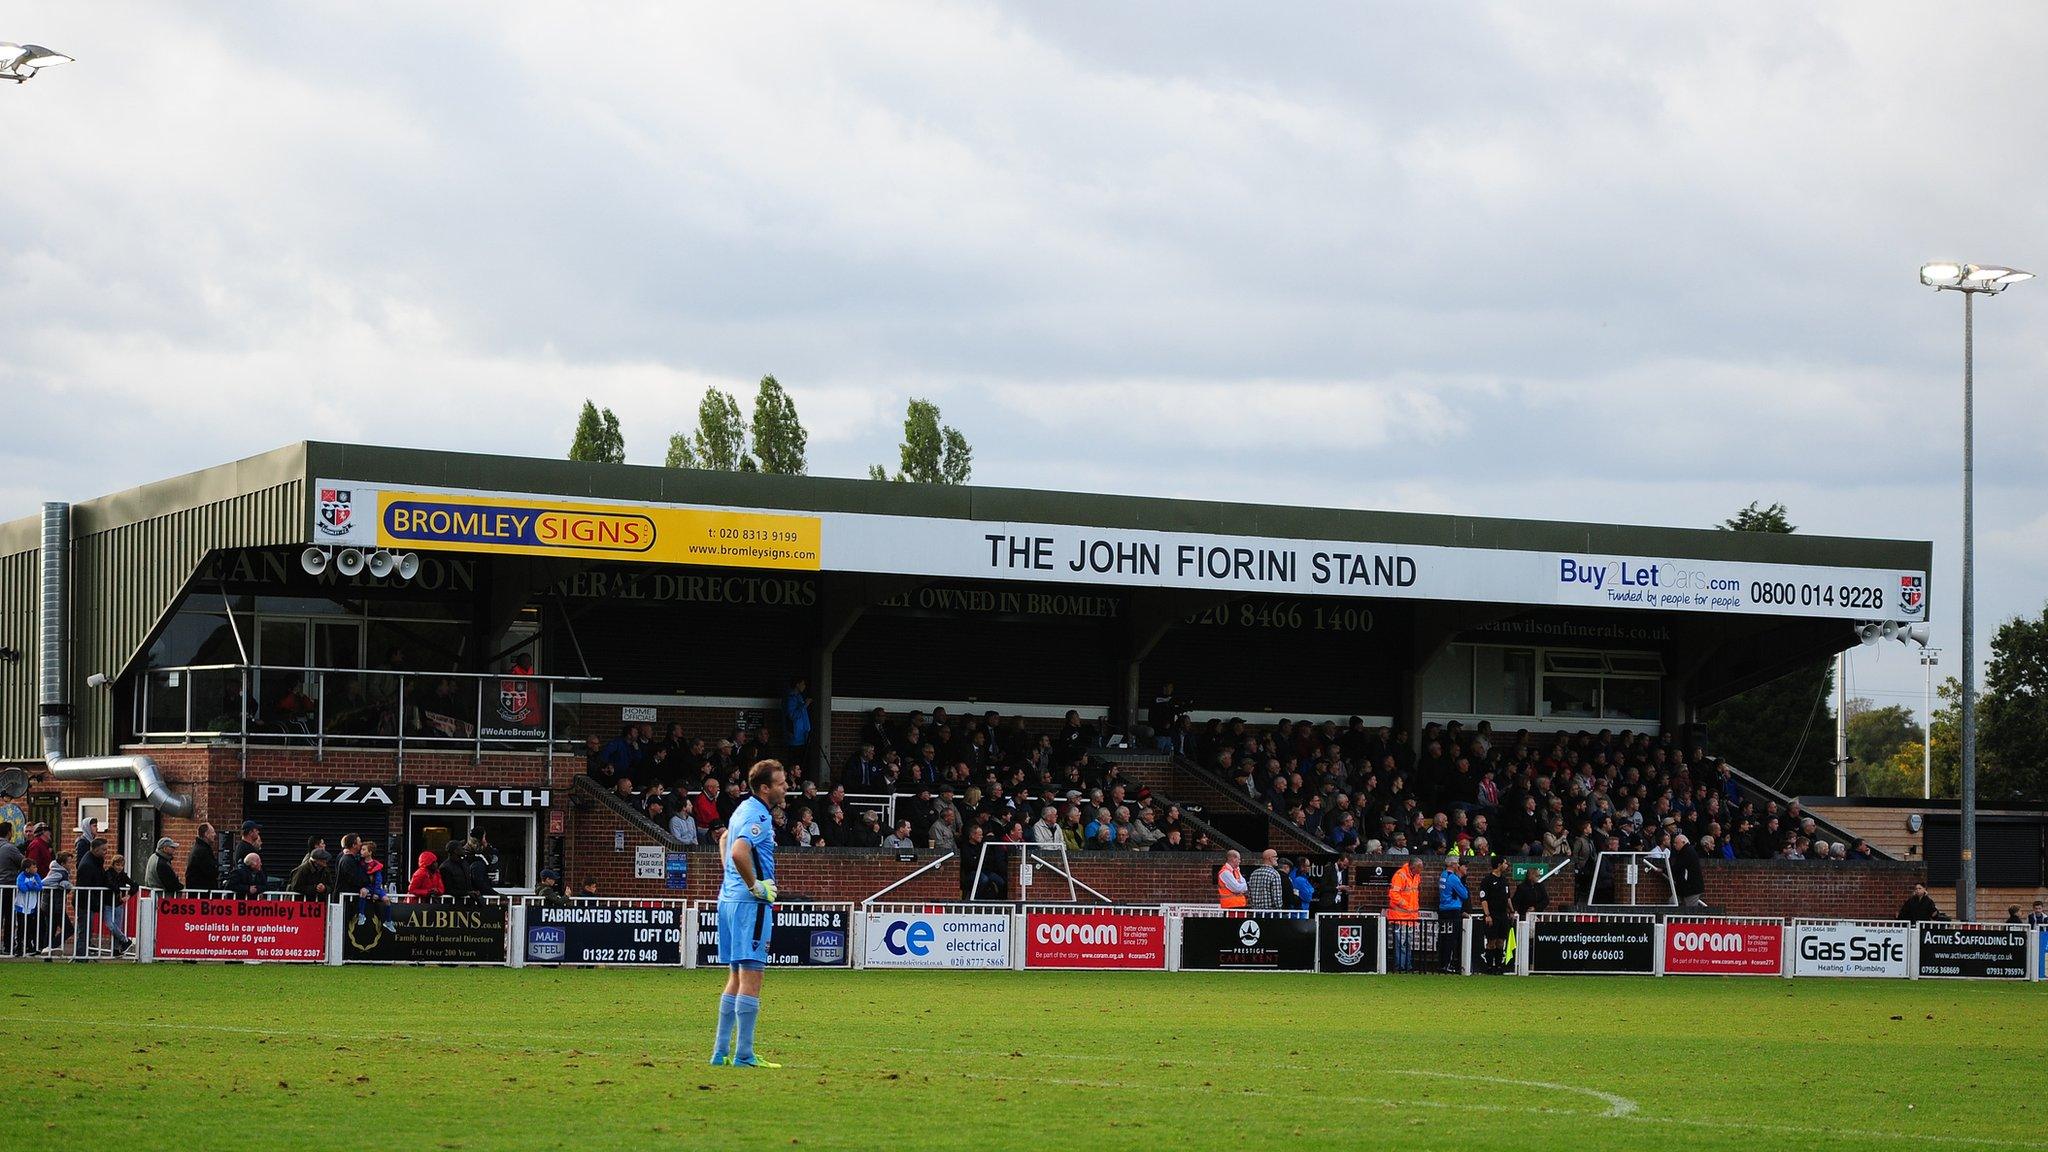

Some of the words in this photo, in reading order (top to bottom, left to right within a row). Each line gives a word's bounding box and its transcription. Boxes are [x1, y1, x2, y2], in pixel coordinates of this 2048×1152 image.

[393, 508, 530, 538] BROMLEY
[541, 517, 640, 544] SIGNS
[708, 528, 716, 538] t:
[719, 529, 739, 539] 020
[743, 530, 768, 540] 8313
[772, 532, 797, 542] 9199
[689, 545, 816, 560] www.bromleysigns.com
[985, 534, 1054, 571] THE
[1069, 540, 1160, 576] JOHN
[1178, 545, 1296, 582] FIORINI
[1311, 552, 1417, 587] STAND
[1560, 558, 1740, 592] Buy2LetCars.com
[653, 575, 817, 606] DIRECTORS
[1751, 582, 1796, 605] 0800
[1801, 584, 1834, 607] 014
[1839, 586, 1883, 610] 9228
[920, 587, 995, 611] OWNED
[999, 592, 1022, 612] IN
[1027, 593, 1121, 618] BROMLEY
[1608, 588, 1644, 602] Funded
[1646, 590, 1657, 607] by
[1661, 592, 1690, 608] people
[1694, 594, 1708, 606] for
[1710, 594, 1741, 610] people
[1240, 602, 1303, 630] 8466
[1313, 605, 1374, 632] 1400
[481, 727, 546, 738] #WeAreBromley
[257, 784, 394, 804] PIZZA
[417, 788, 550, 807] HATCH
[161, 901, 196, 916] Cass
[201, 902, 233, 917] Bros
[237, 902, 294, 920] Bromley
[299, 903, 321, 918] Ltd
[541, 908, 612, 923] FABRICATED
[614, 909, 648, 924] STEEL
[651, 910, 674, 924] FOR
[777, 913, 830, 927] BUILDERS
[832, 914, 841, 926] &
[943, 920, 1005, 932] command
[185, 922, 230, 932] Specialists
[231, 923, 240, 932] in
[257, 924, 299, 934] upholstery
[1036, 923, 1118, 944] coram
[208, 934, 220, 942] for
[242, 934, 252, 943] 50
[254, 936, 276, 944] years
[394, 934, 417, 944] Family
[419, 934, 434, 943] Run
[436, 935, 462, 943] Funeral
[463, 935, 494, 943] Directors
[535, 932, 559, 941] MAH
[634, 928, 662, 942] LOFT
[664, 929, 680, 943] CO
[816, 936, 838, 945] MAH
[884, 920, 935, 956] ce
[1537, 932, 1649, 944] www.prestigecarskent.co.uk
[1673, 932, 1742, 952] coram
[1924, 931, 1953, 945] ACTIVE
[1954, 931, 2007, 946] SCAFFOLDING
[2009, 933, 2025, 946] LTD
[533, 944, 561, 954] STEEL
[946, 939, 1001, 951] electrical
[1800, 936, 1846, 960] Gas
[1849, 937, 1903, 962] Safe
[160, 948, 249, 957] www.carseatrepairs.com
[256, 948, 269, 956] Tel:
[270, 948, 284, 956] 020
[411, 948, 424, 956] Est.
[426, 948, 442, 957] Over
[445, 948, 456, 956] 200
[458, 949, 477, 957] Years
[582, 949, 614, 961] 01322
[617, 949, 636, 961] 276
[639, 949, 658, 961] 948
[813, 948, 840, 957] STEEL
[1043, 951, 1052, 959] part
[1561, 949, 1589, 960] 01689
[1591, 950, 1624, 961] 660603
[1934, 952, 2013, 961] www.activescaffolding.co.uk
[951, 958, 964, 966] 020
[966, 958, 984, 966] 8777
[987, 958, 1004, 966] 5868
[1817, 964, 1844, 973] Heating
[1854, 965, 1885, 973] Plumbing
